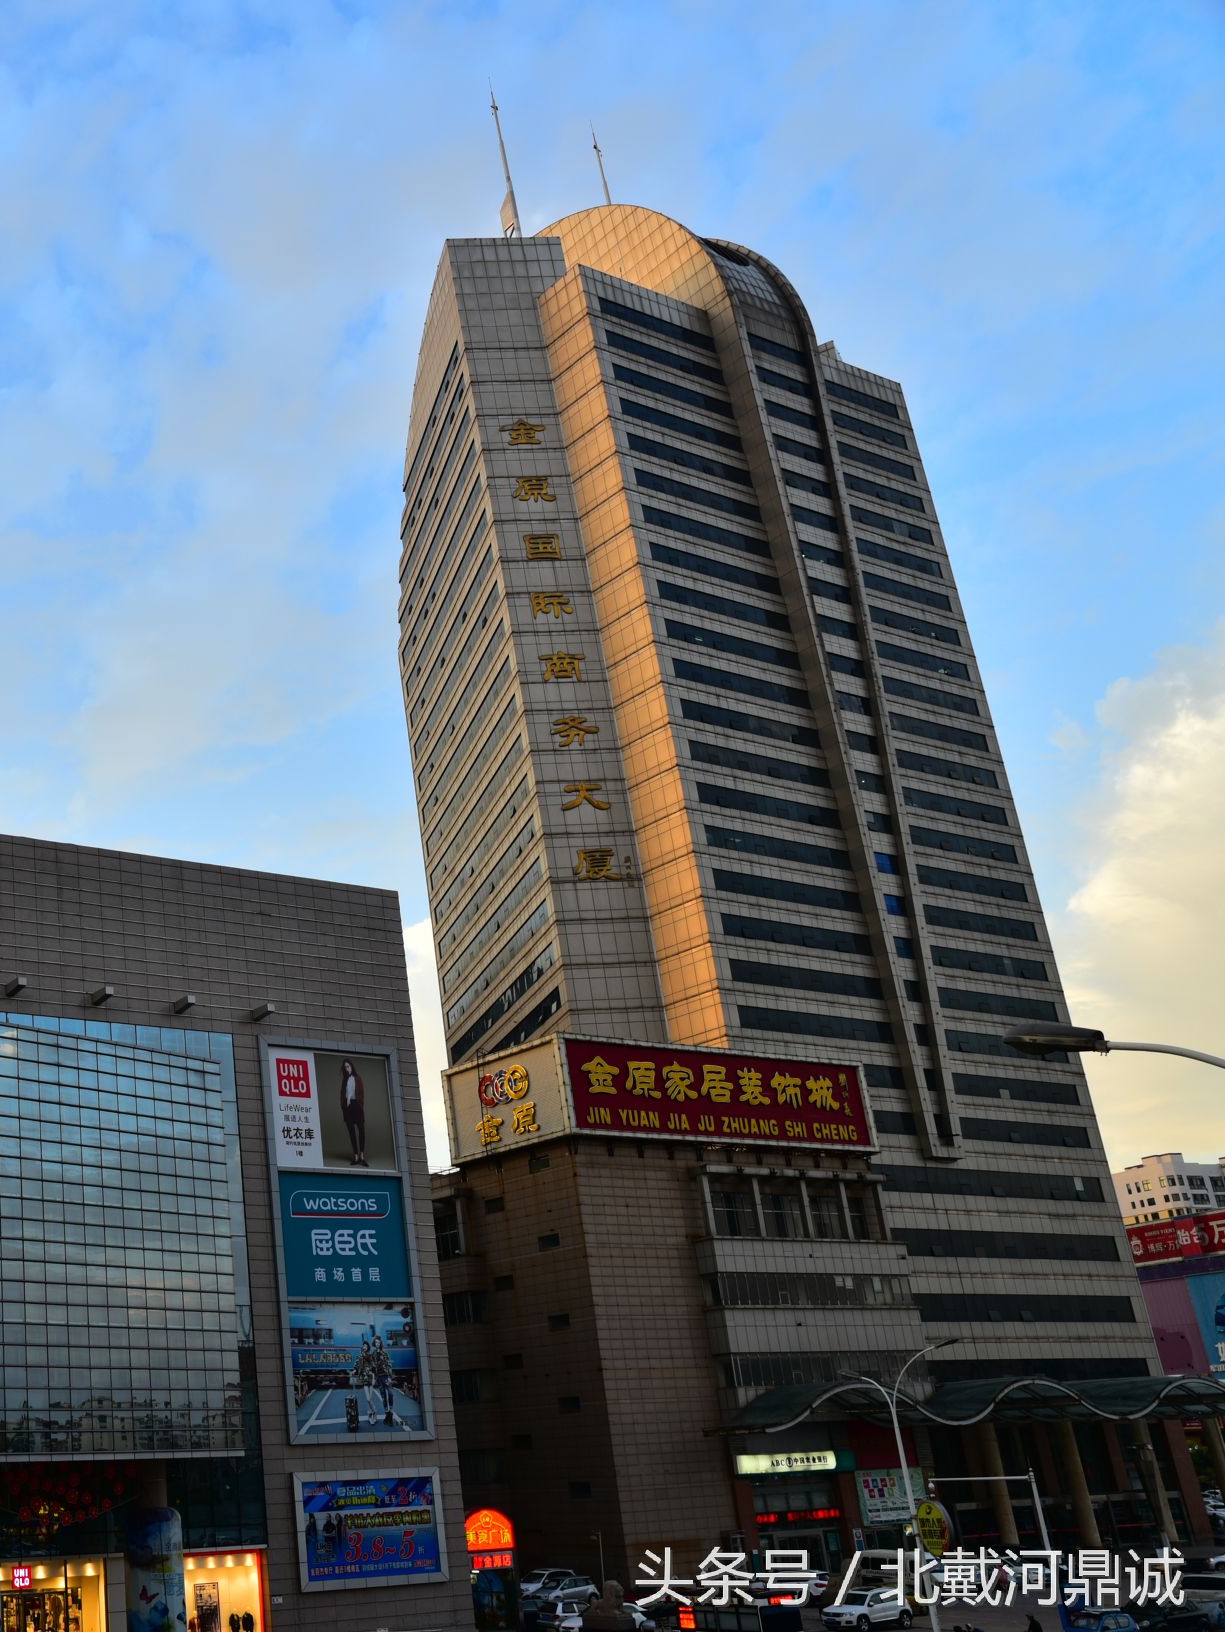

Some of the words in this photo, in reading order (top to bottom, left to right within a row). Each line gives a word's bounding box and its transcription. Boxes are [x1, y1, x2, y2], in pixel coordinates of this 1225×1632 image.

[279, 1063, 304, 1078] UNI
[281, 1078, 307, 1094] QLO
[580, 1055, 841, 1111] 金原家居装饰城
[279, 1103, 312, 1114] LifeWear
[475, 1101, 541, 1147] 金原
[586, 1107, 612, 1126] JIN
[618, 1108, 660, 1130] YUAN
[667, 1110, 691, 1132] JIA
[697, 1112, 716, 1134] JU
[722, 1113, 779, 1138] ZHUANG
[784, 1118, 808, 1139] SHI
[812, 1120, 858, 1142] CHENG
[281, 1126, 316, 1141] 优衣库
[303, 1196, 378, 1212] watsons
[311, 1228, 378, 1256] 屈臣氏
[313, 1266, 382, 1283] 商场首层
[770, 1459, 785, 1467] ABC
[466, 1529, 511, 1546] 美食广场
[13, 1568, 29, 1578] UNI
[13, 1578, 30, 1588] QLO
